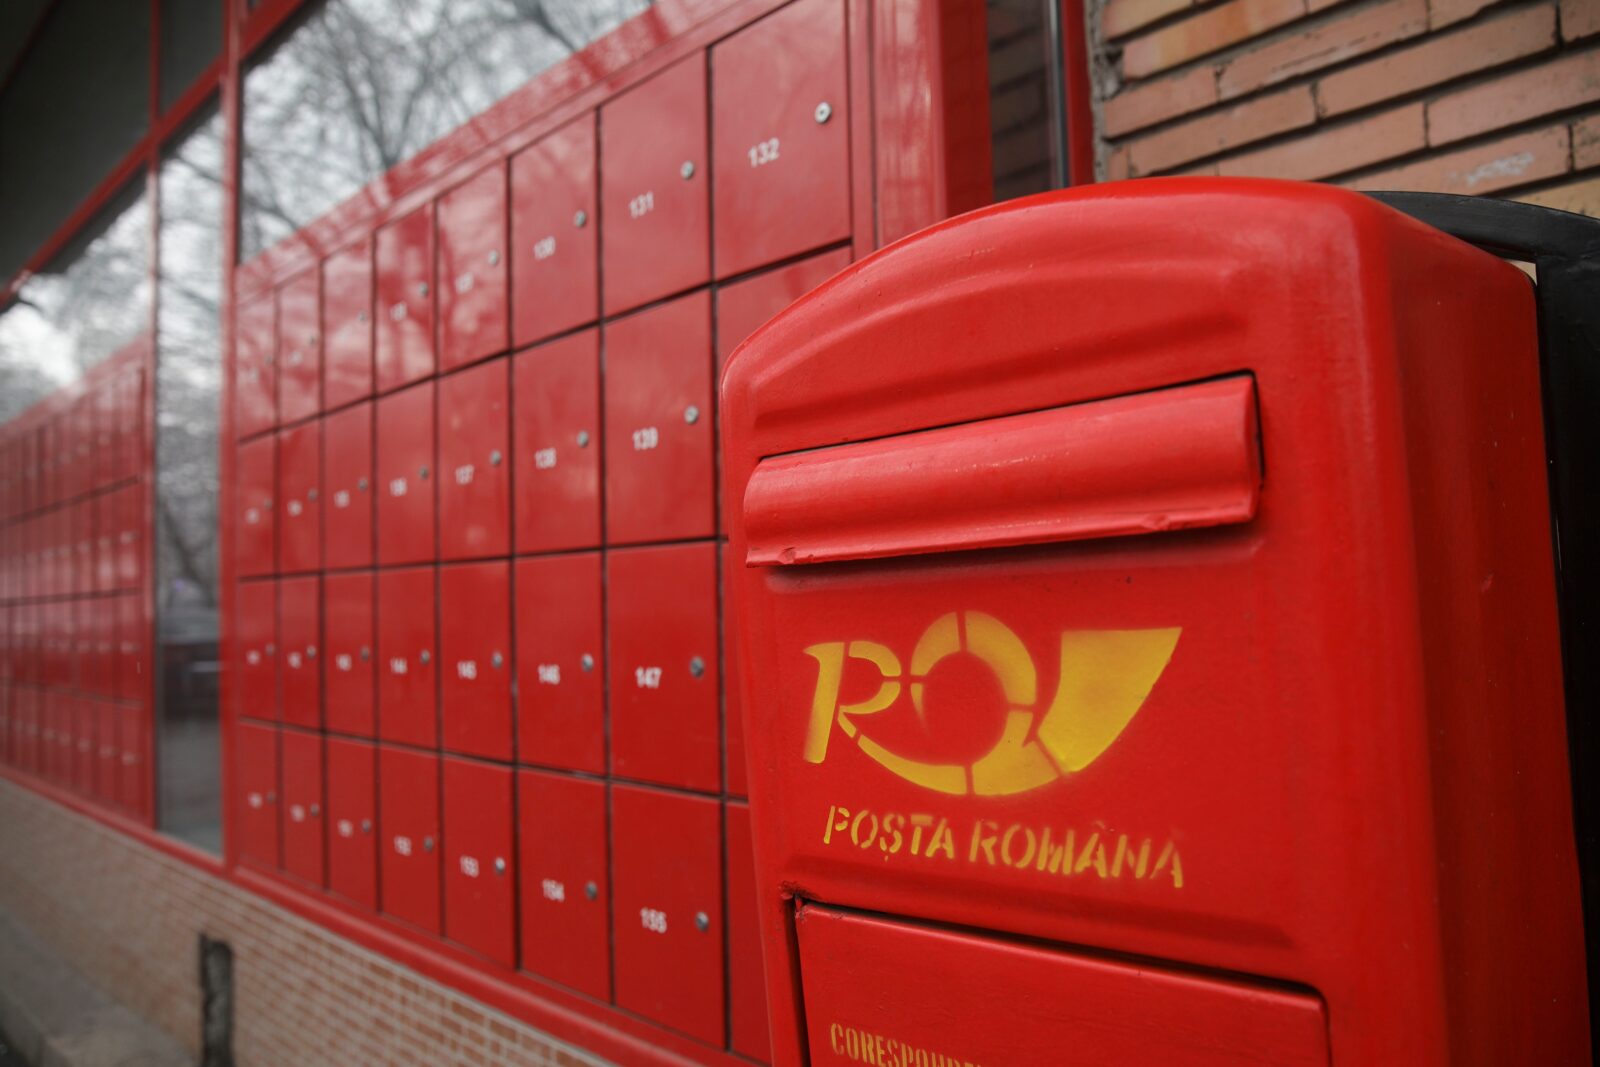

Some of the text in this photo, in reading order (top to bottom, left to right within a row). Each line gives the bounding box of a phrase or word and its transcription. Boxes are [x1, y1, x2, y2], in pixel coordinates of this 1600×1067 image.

[748, 137, 780, 168] 132
[628, 190, 654, 219] 131
[632, 427, 658, 450] 139
[635, 666, 663, 689] 147
[640, 906, 667, 934] 155
